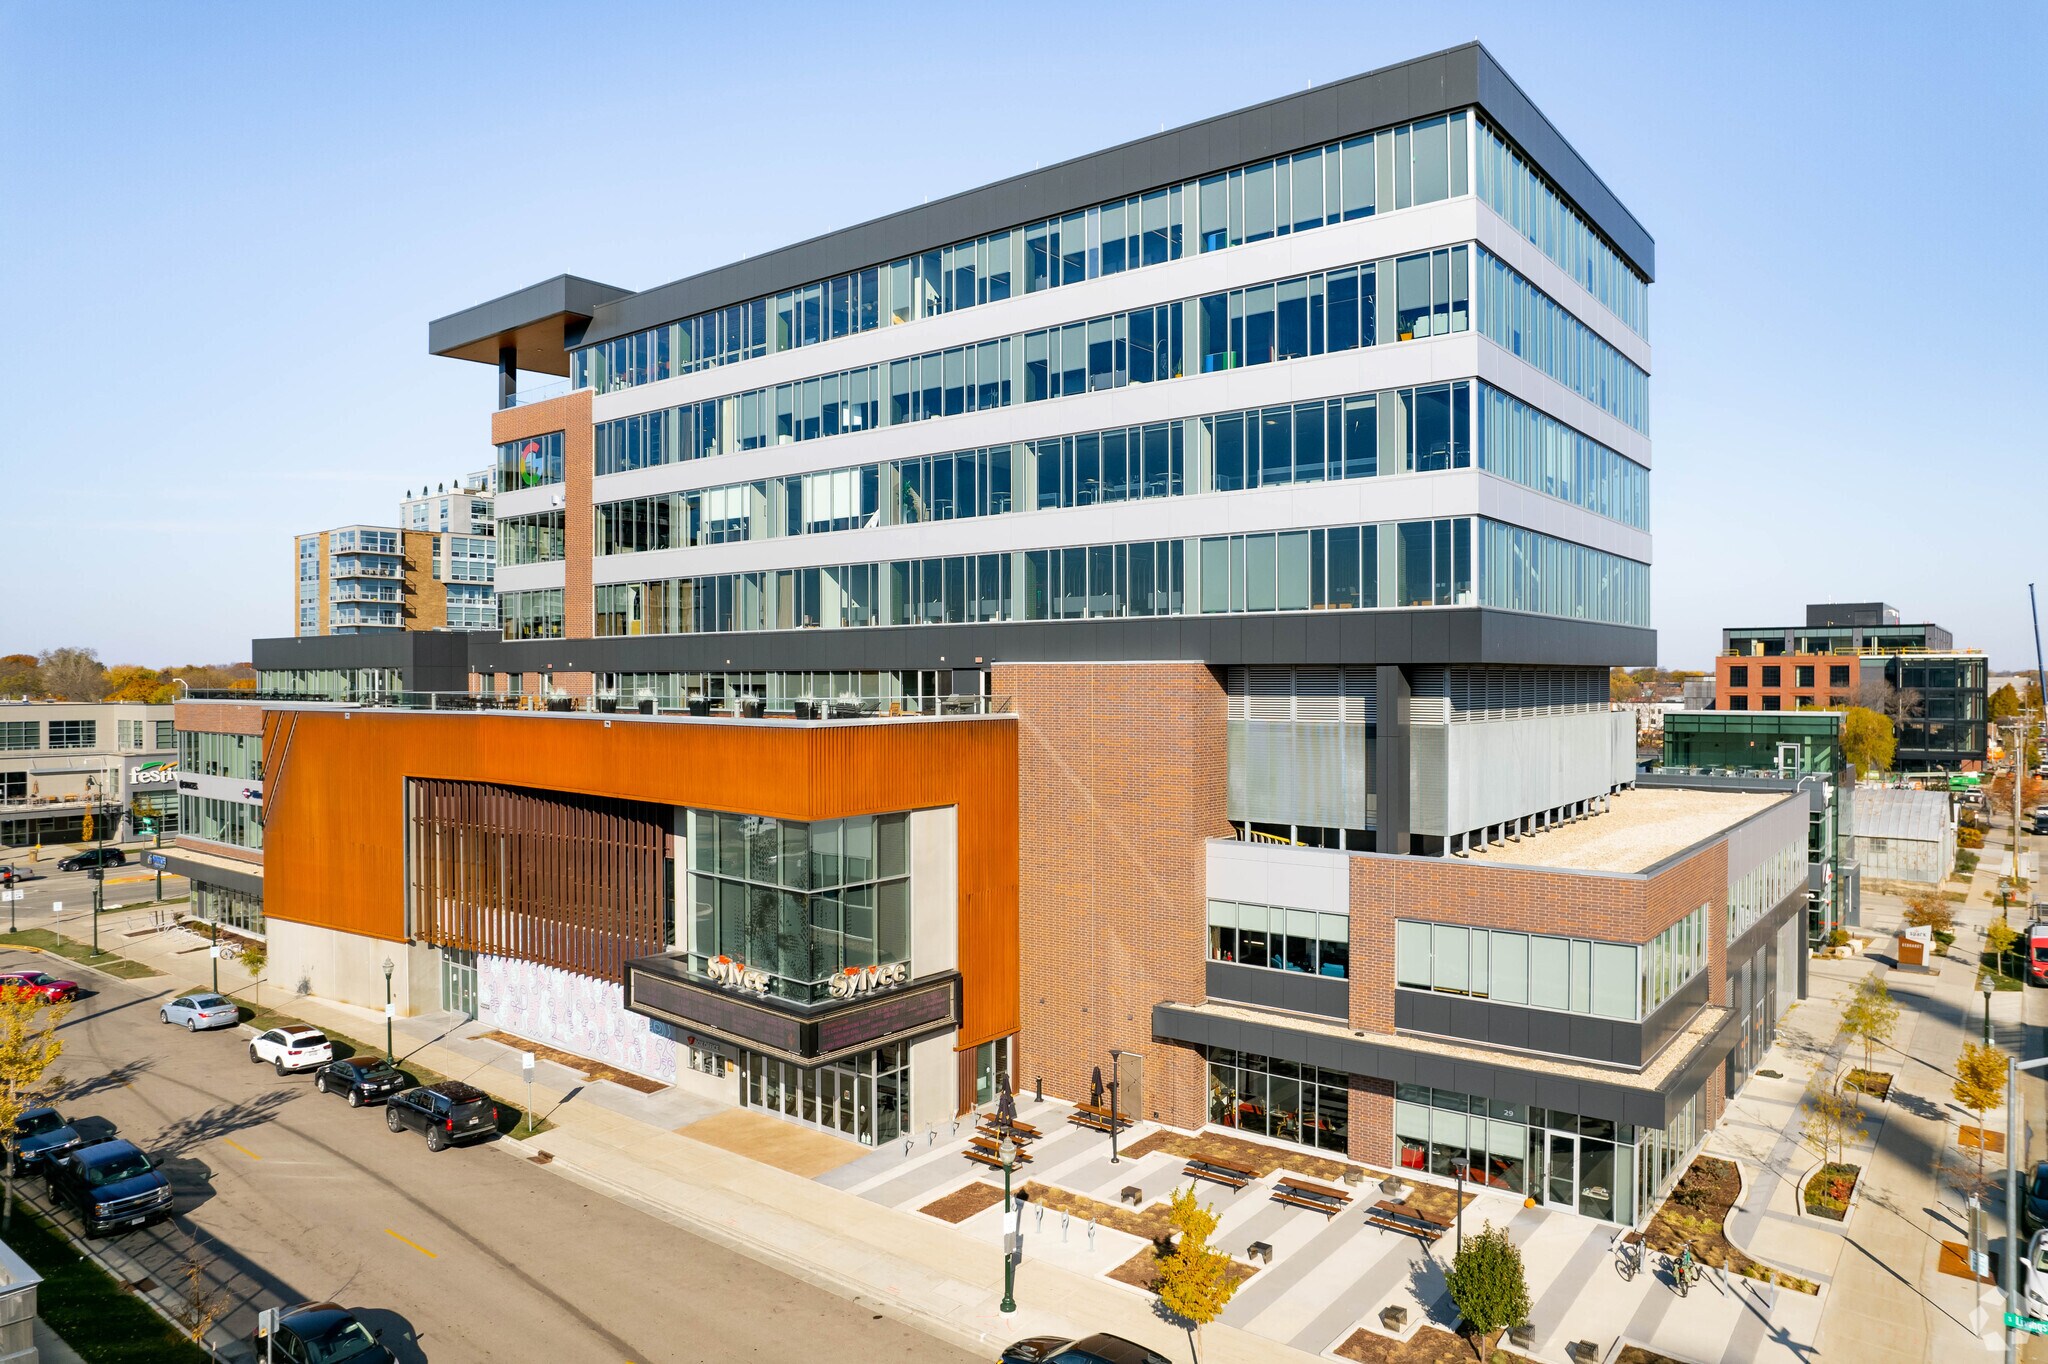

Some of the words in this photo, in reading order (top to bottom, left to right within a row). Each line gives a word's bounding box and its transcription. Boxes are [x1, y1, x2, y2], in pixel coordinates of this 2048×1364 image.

[707, 955, 769, 992] Sylvee
[828, 964, 906, 998] Sylvee
[1503, 1109, 1514, 1117] 29
